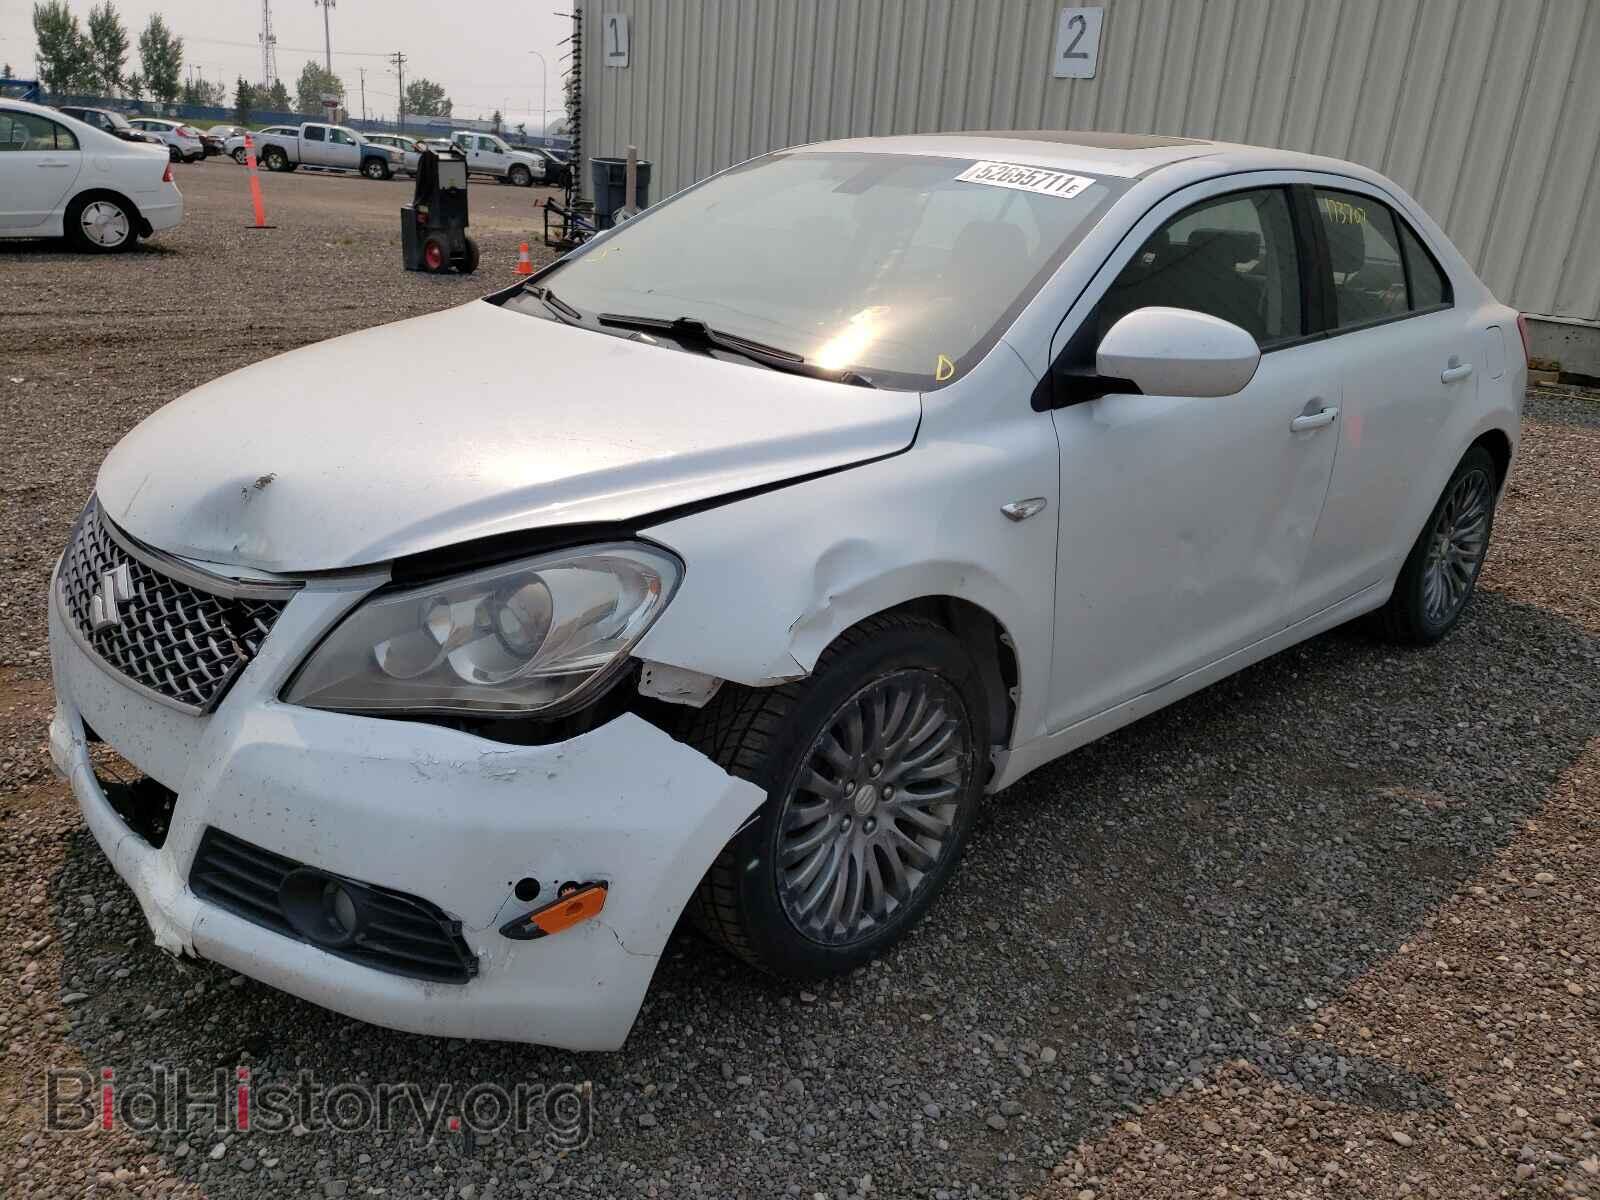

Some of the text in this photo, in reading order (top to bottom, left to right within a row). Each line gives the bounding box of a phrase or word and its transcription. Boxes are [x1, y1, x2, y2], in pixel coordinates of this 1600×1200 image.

[608, 18, 626, 57] 1
[1063, 14, 1088, 59] 2
[935, 354, 955, 381] D
